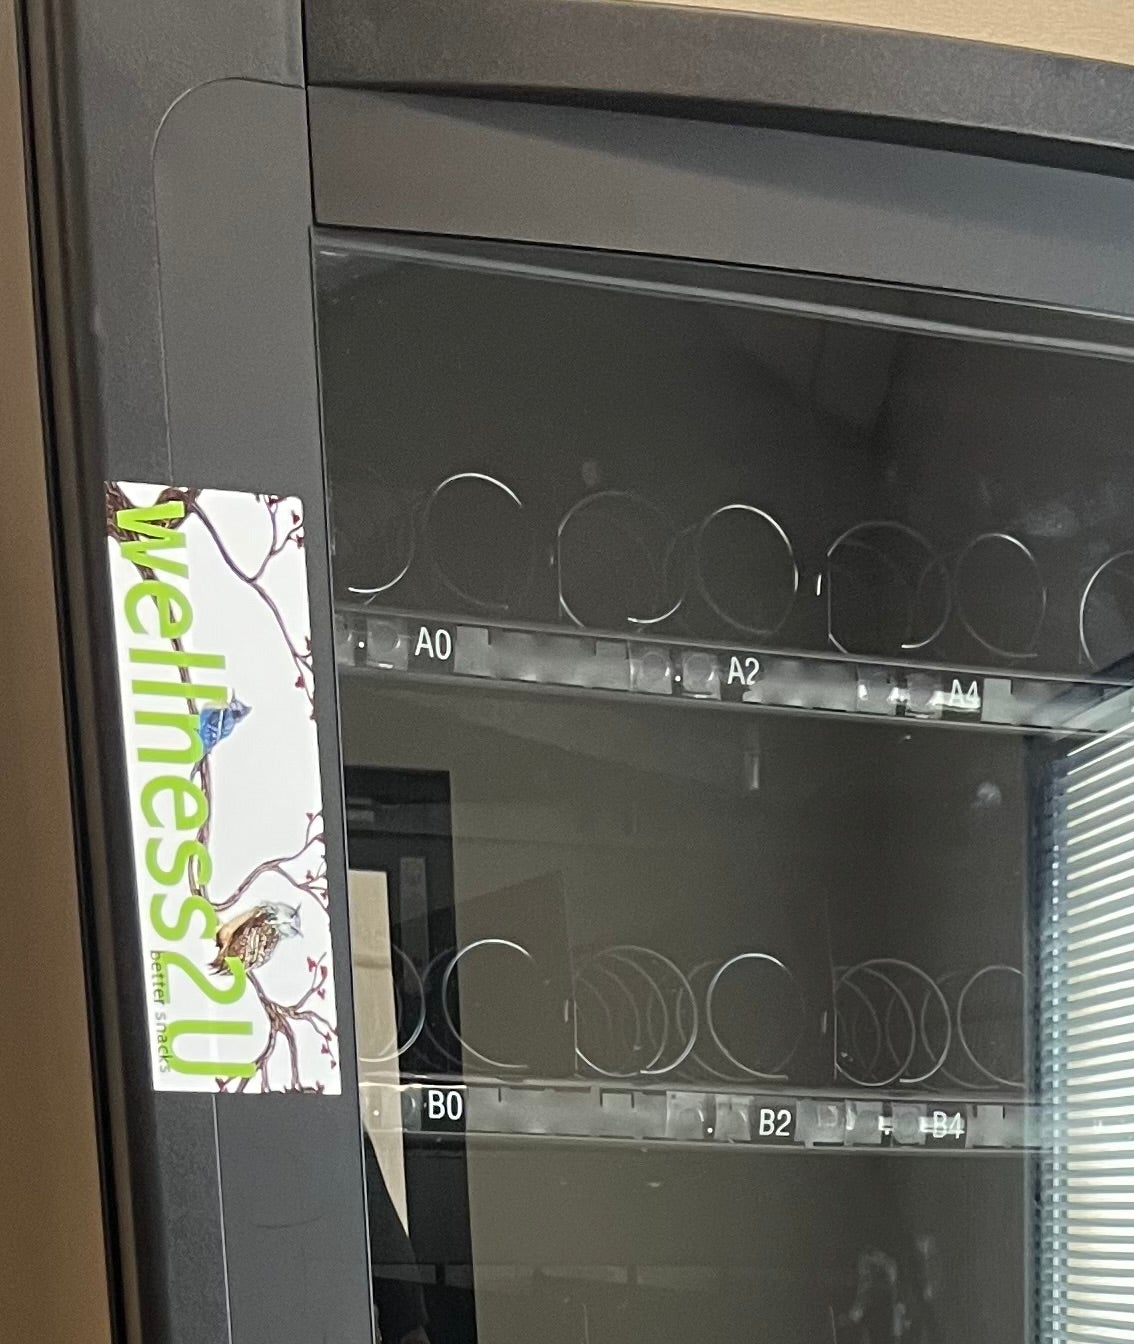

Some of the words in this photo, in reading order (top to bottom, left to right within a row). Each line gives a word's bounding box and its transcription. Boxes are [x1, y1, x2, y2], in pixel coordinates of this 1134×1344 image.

[415, 627, 452, 661] A0
[727, 657, 760, 687] A2
[950, 680, 979, 706] A4
[116, 500, 257, 1079] wellness2U
[151, 950, 166, 1005] better
[155, 1012, 173, 1073] snacks
[428, 1090, 463, 1121] B0
[759, 1109, 792, 1136] B2
[933, 1111, 965, 1139] B4
